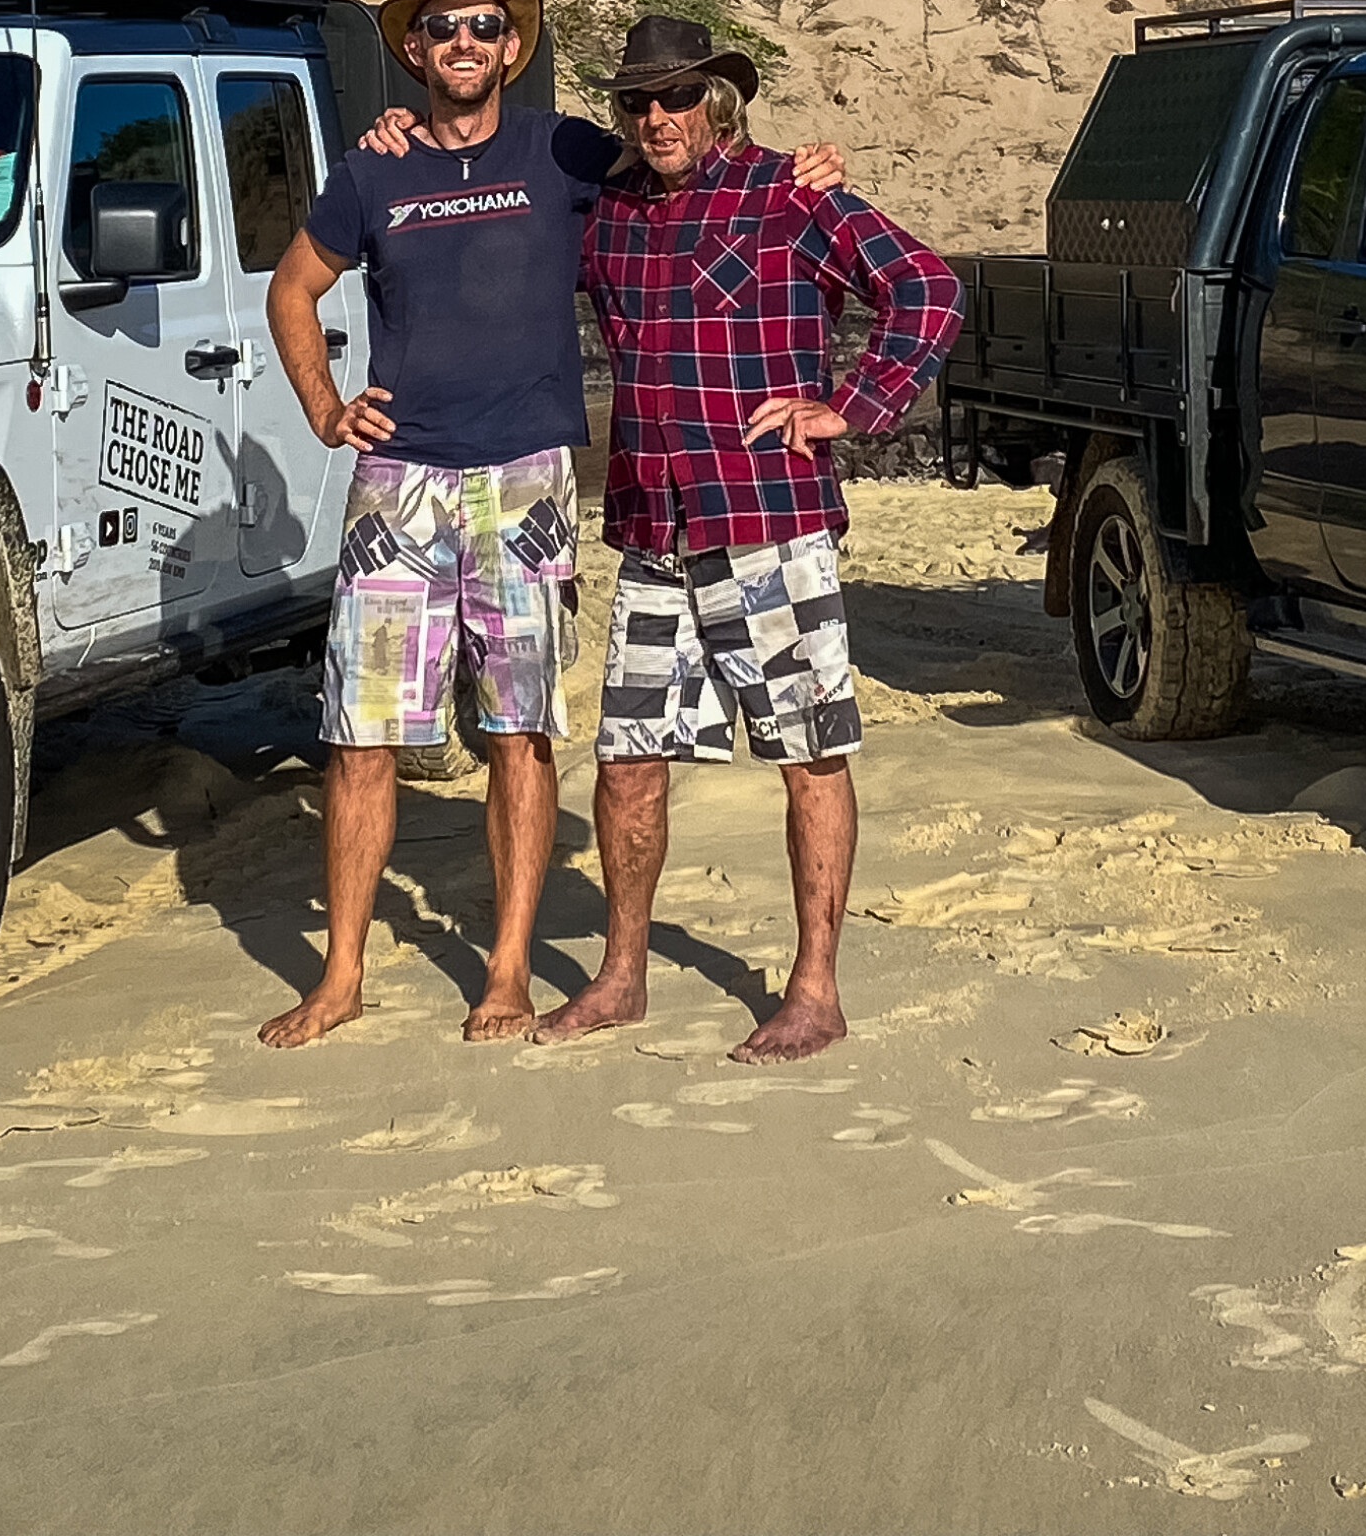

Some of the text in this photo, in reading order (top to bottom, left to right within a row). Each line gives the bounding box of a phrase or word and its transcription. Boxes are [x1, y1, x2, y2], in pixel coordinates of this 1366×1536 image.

[419, 190, 531, 220] YOKOHAMA
[110, 396, 204, 465] THE ROAD
[107, 439, 202, 506] CHOSE ME
